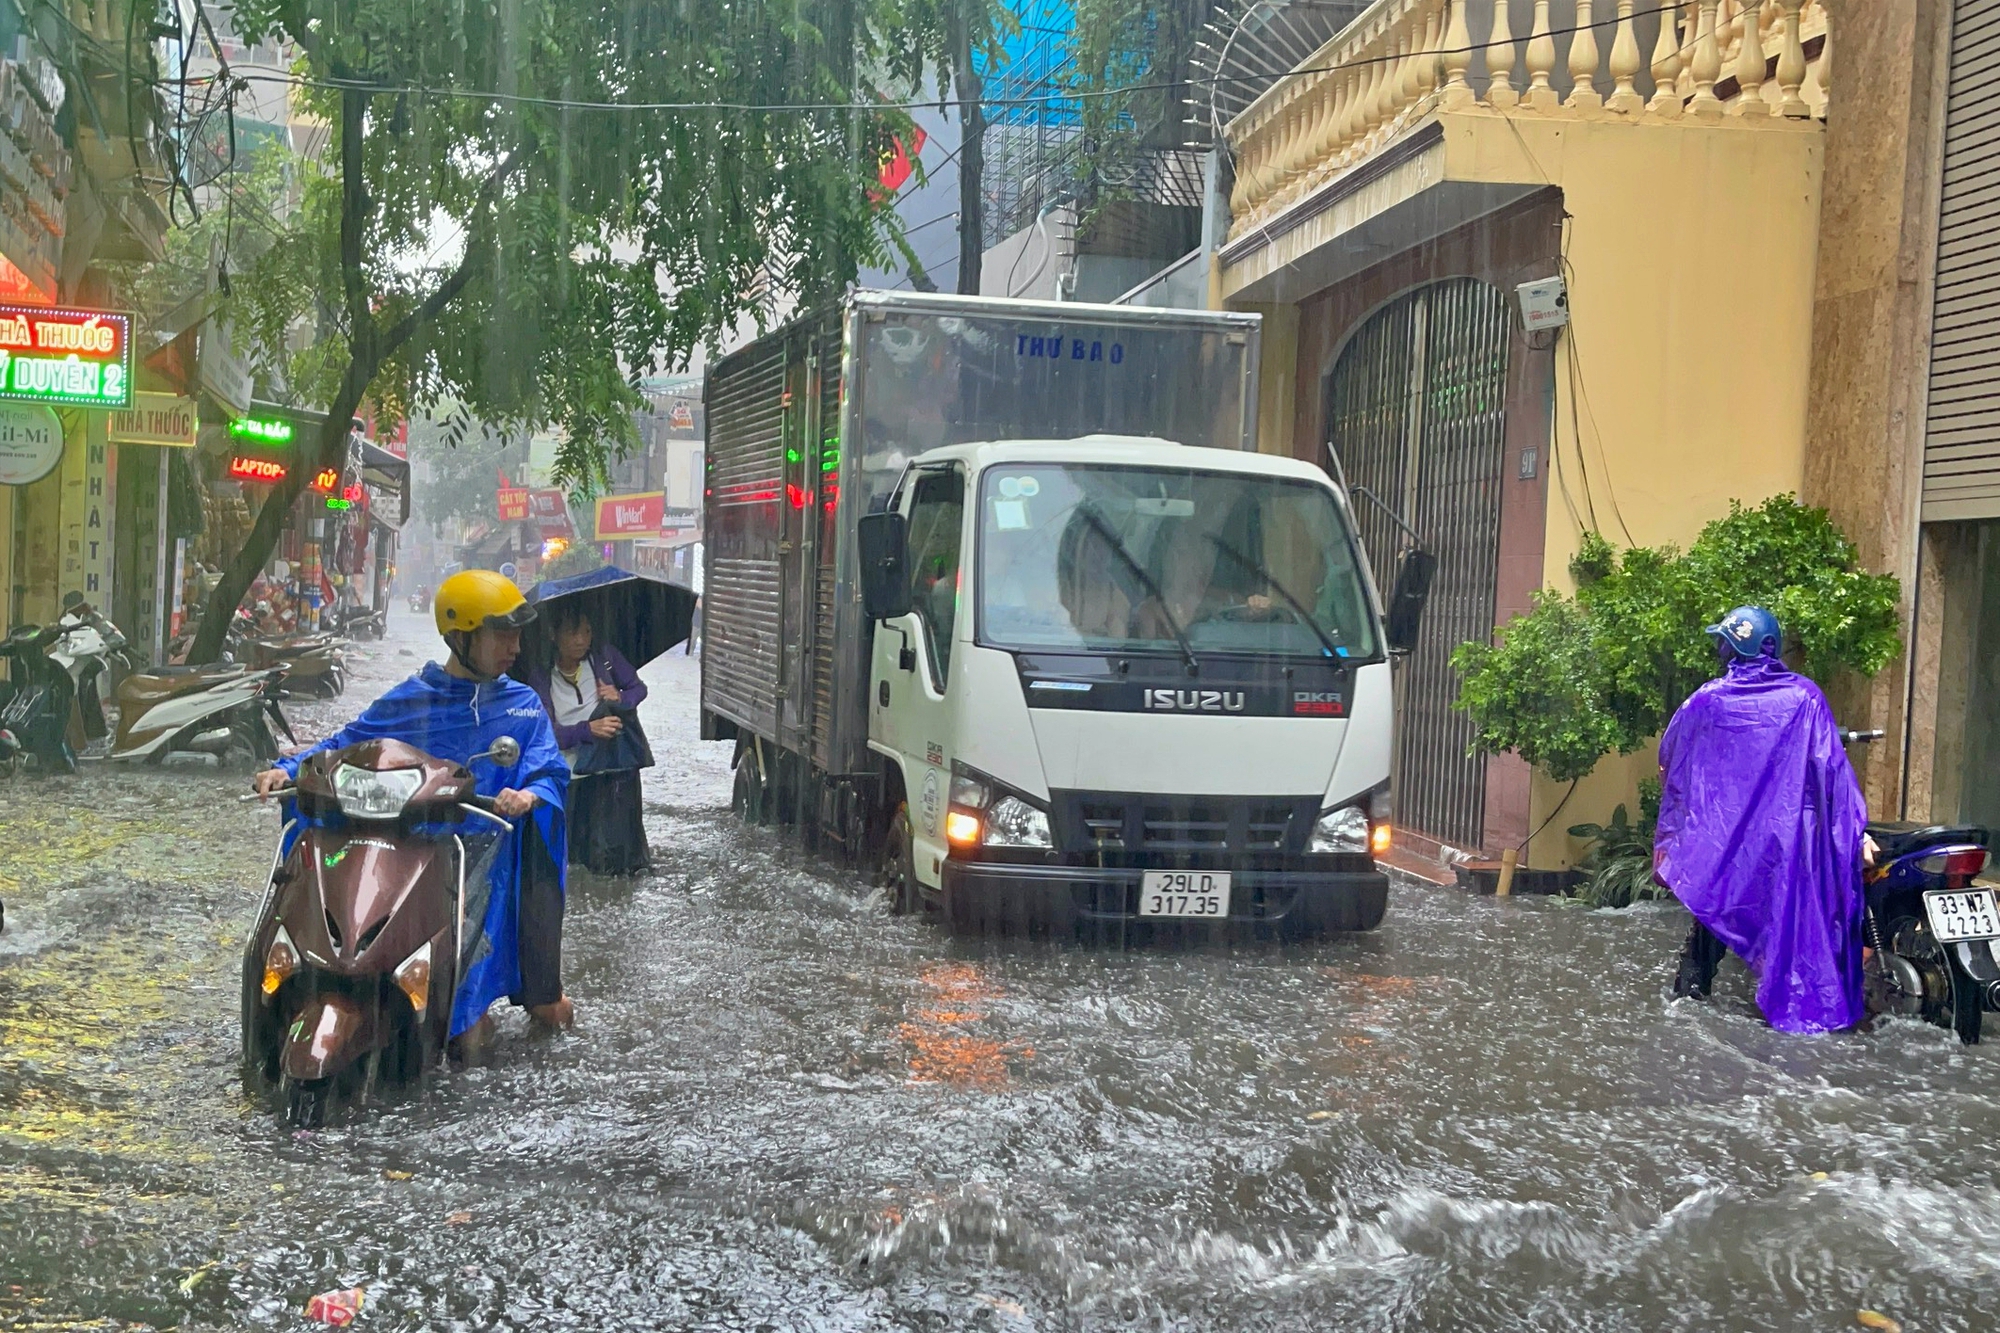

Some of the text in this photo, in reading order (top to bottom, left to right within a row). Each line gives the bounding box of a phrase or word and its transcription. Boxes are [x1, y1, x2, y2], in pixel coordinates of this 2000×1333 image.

[35, 316, 115, 352] THUỐC
[1017, 333, 1064, 359] THƯ
[14, 353, 100, 395] DUYÊN
[102, 364, 122, 397] 2
[116, 404, 143, 433] NHÀ
[1144, 688, 1245, 712] ISUZU
[1161, 874, 1212, 893] 29LD
[1149, 895, 1220, 915] 317.35
[1947, 915, 1993, 936] 4223
